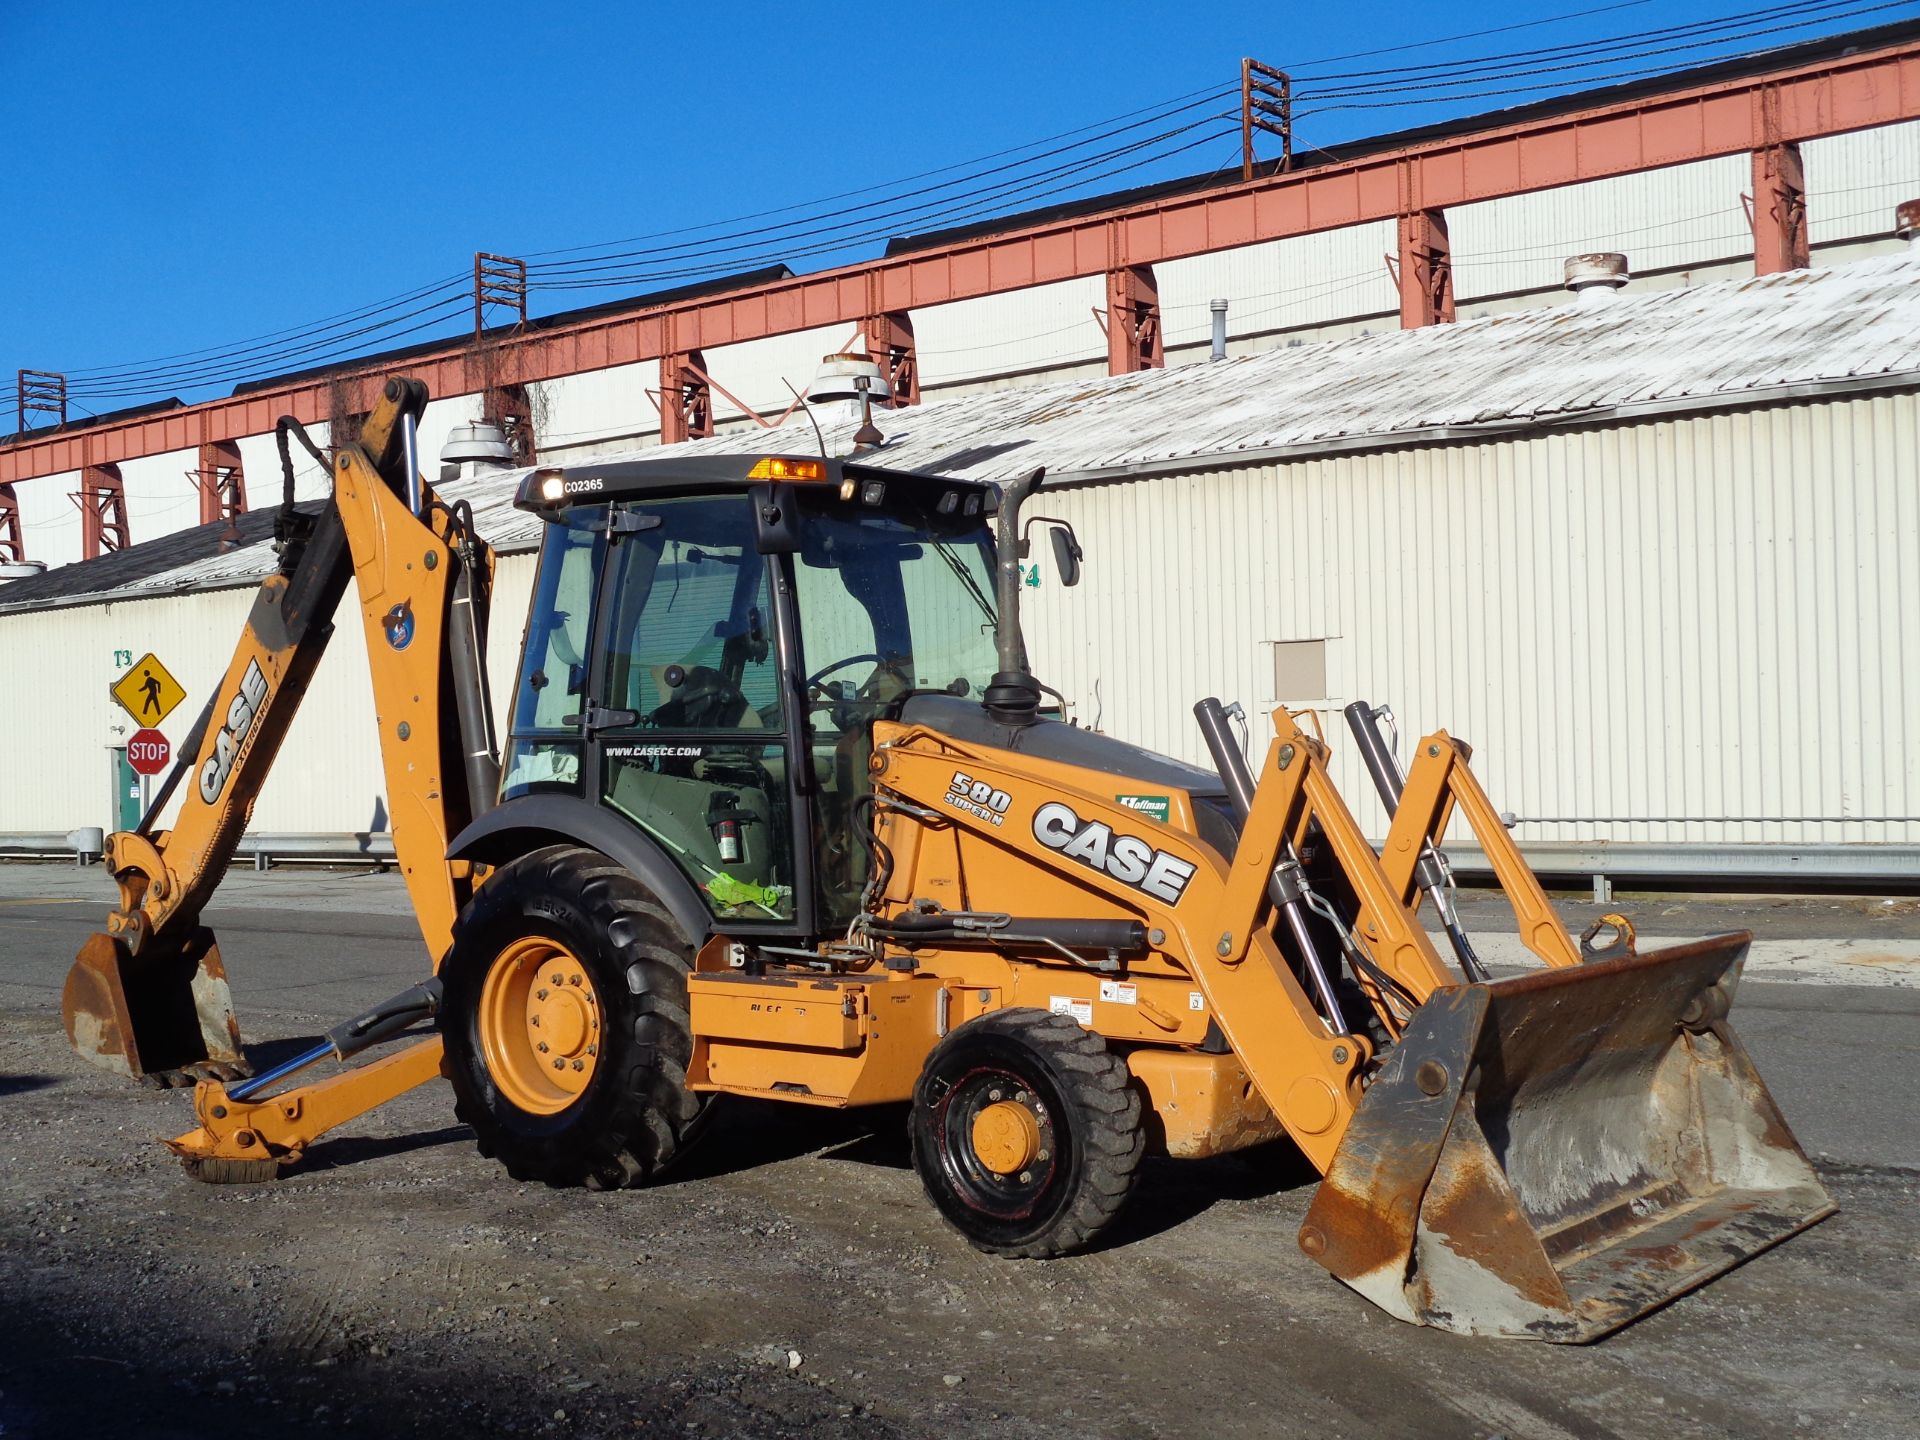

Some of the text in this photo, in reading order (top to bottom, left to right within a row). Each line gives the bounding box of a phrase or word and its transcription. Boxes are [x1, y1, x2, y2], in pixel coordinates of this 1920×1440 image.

[1019, 563, 1041, 588] 4
[114, 649, 133, 668] T3
[199, 655, 269, 805] CASE
[130, 742, 168, 760] STOP
[606, 747, 702, 756] WWW.CASECE.COM
[949, 770, 1013, 813] 580
[943, 791, 1005, 827] SUPER N
[1032, 801, 1198, 908] CASE
